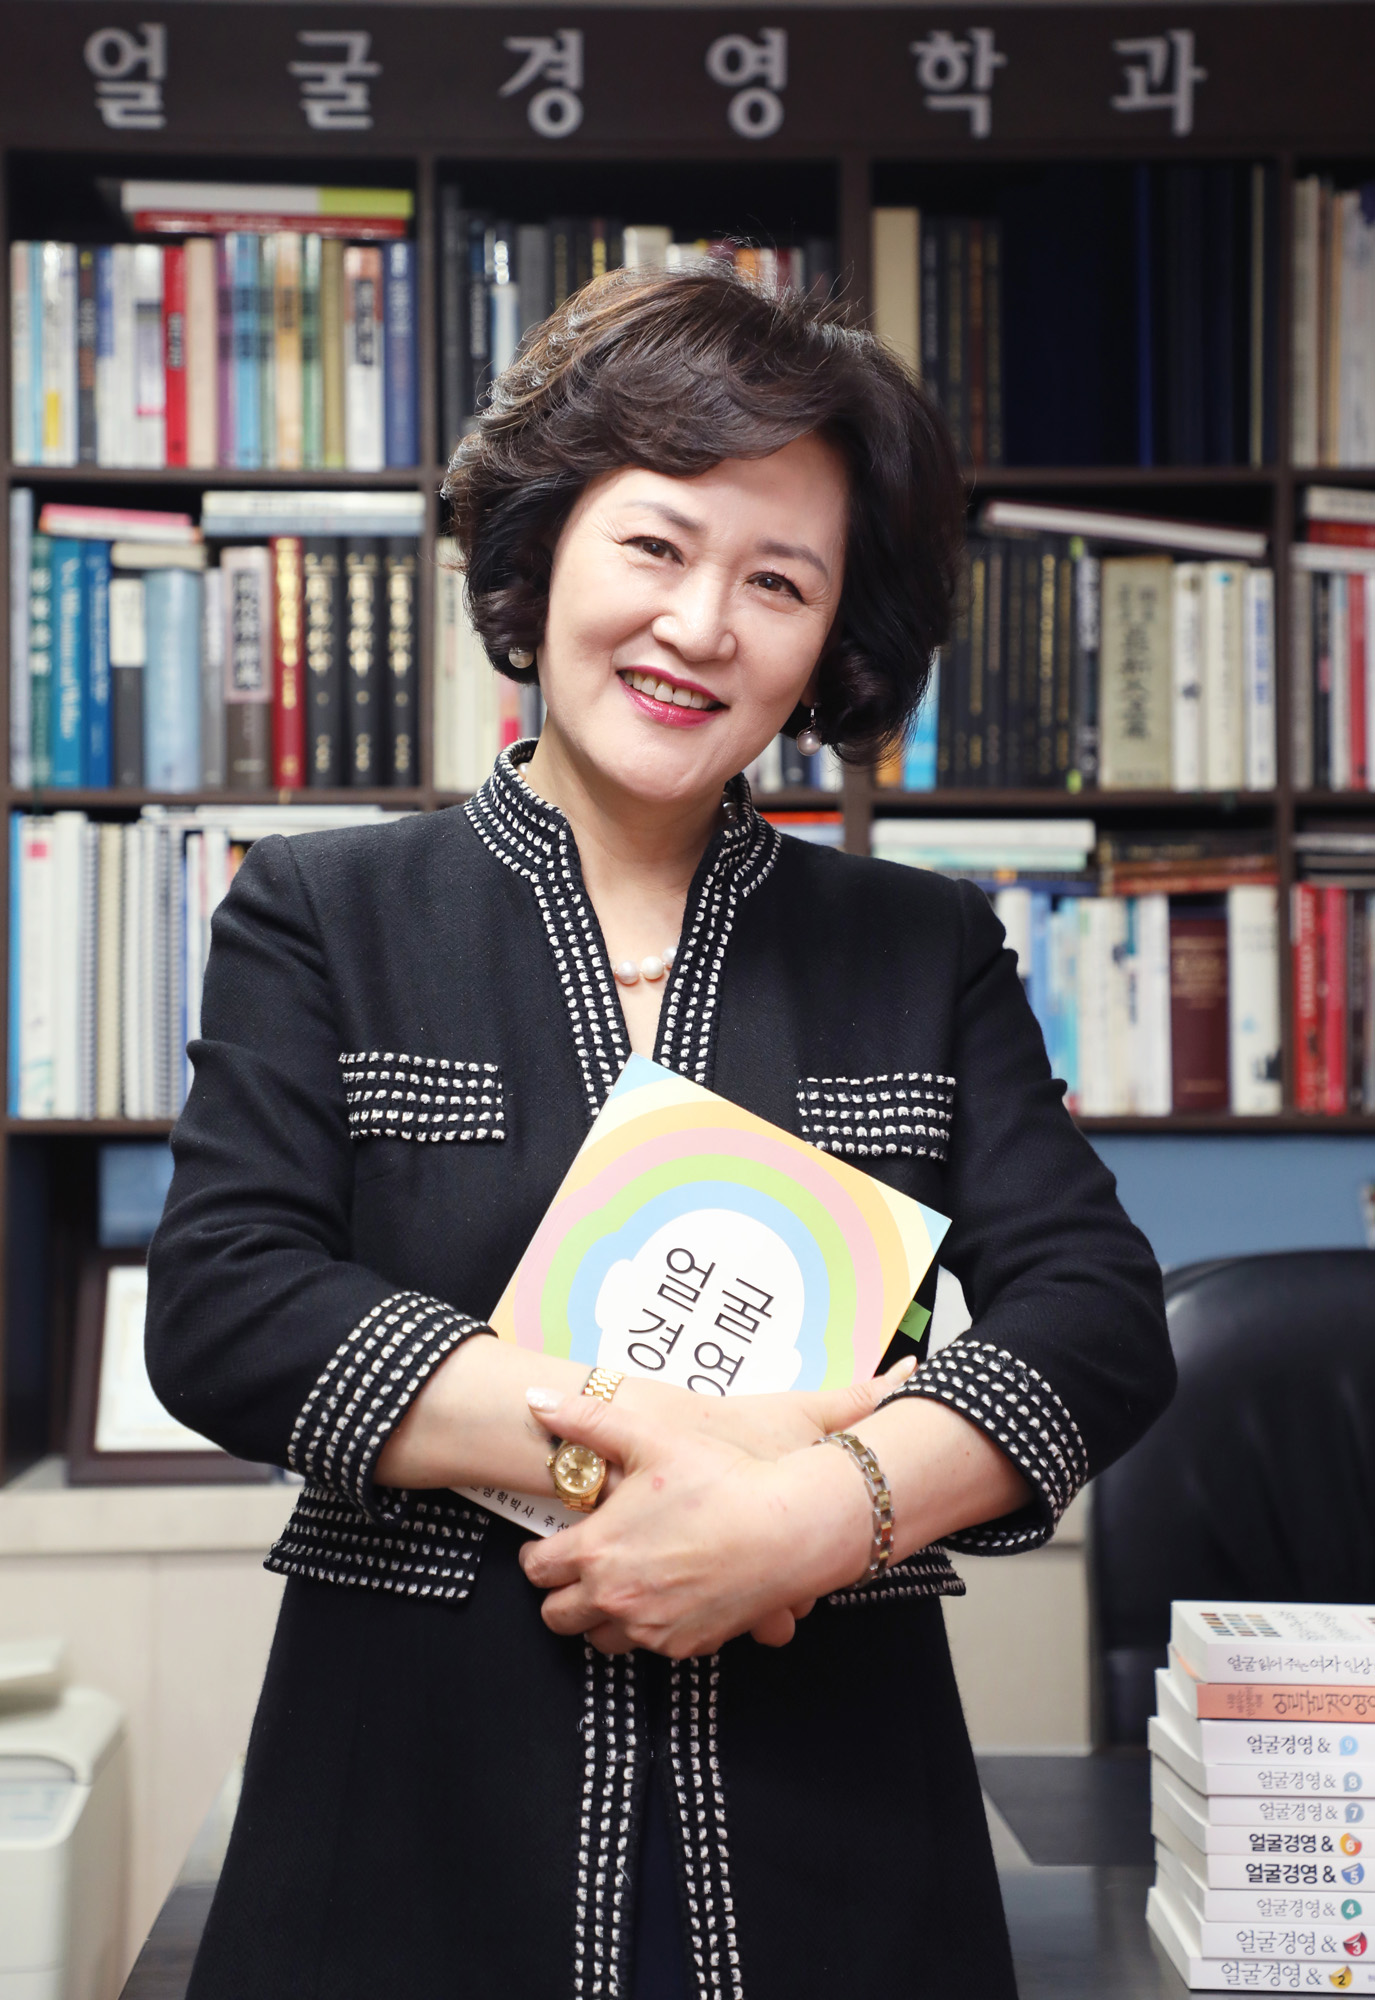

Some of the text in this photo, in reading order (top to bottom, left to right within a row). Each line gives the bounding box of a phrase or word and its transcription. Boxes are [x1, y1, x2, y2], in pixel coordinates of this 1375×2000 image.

[657, 1247, 775, 1344] 얼굴
[627, 1307, 745, 1398] 경영
[1227, 1654, 1256, 1673] 얼굴
[1247, 1734, 1353, 1755] 얼굴경영 & 9
[1257, 1771, 1358, 1790] 얼굴경영 & 8
[1259, 1802, 1359, 1822] 얼굴경영 & 7
[1249, 1833, 1356, 1853] 얼굴경영 & 6
[1246, 1863, 1359, 1884] 얼굴경영 & 5
[1256, 1898, 1356, 1918] 얼굴경영 & 4
[1236, 1929, 1362, 1955] 얼굴경영 & 3
[1221, 1961, 1301, 1988] 얼굴경영
[1306, 1967, 1323, 1986] &
[1338, 1974, 1346, 1986] 2
